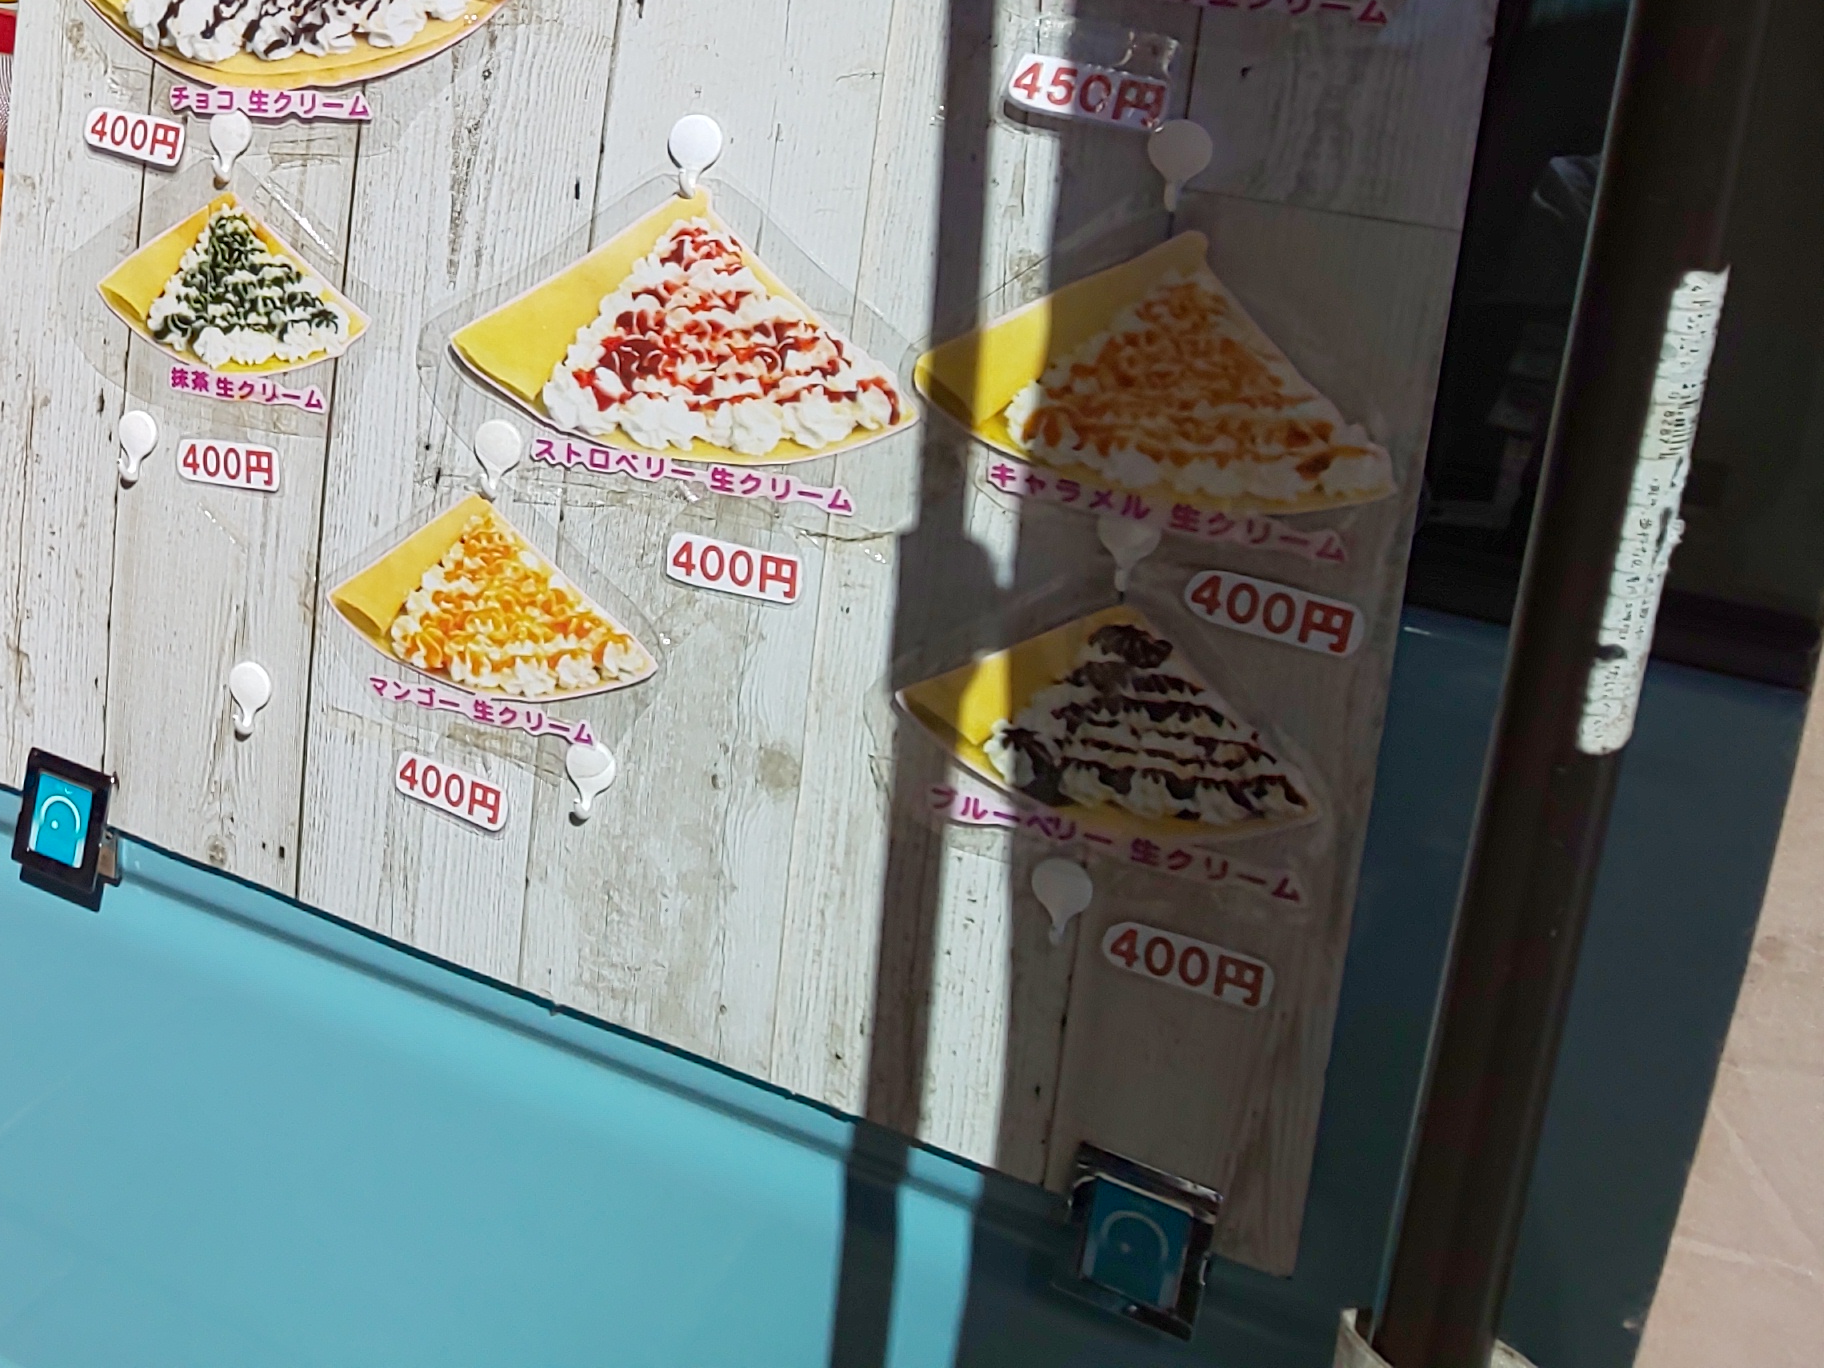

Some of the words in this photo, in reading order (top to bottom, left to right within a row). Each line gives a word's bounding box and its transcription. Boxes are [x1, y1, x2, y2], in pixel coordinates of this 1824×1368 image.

[1012, 61, 1166, 129] 450円
[90, 111, 181, 160] 400円
[181, 443, 274, 487] 400円
[672, 540, 799, 600] 400円
[1190, 574, 1355, 654] 400円
[398, 757, 502, 825] 400円
[1109, 927, 1265, 1008] 400円
